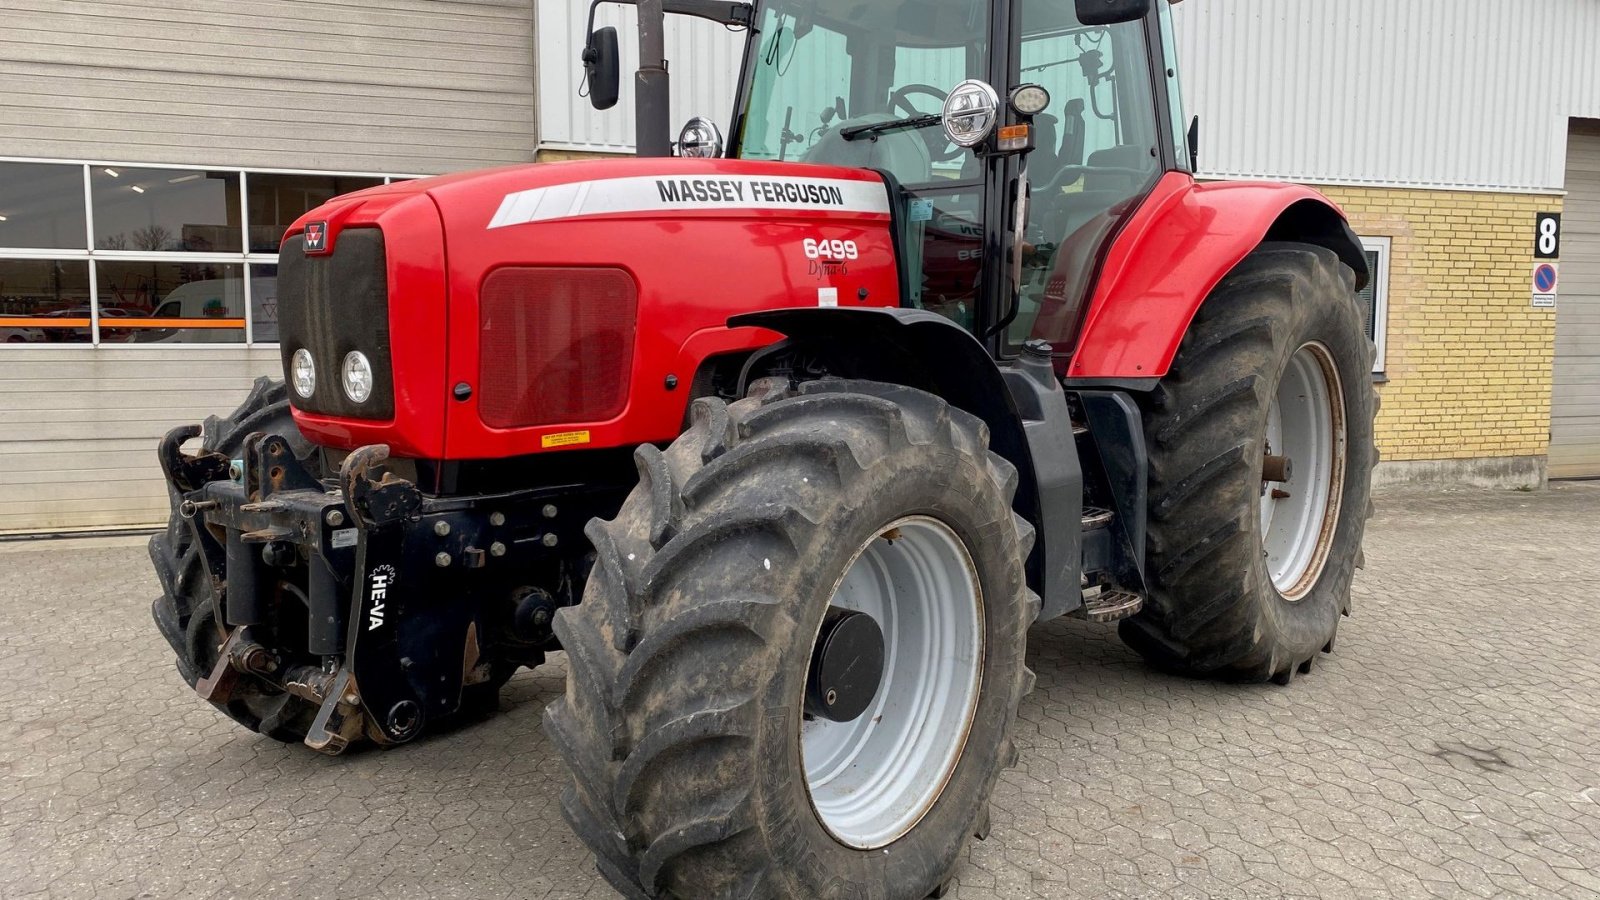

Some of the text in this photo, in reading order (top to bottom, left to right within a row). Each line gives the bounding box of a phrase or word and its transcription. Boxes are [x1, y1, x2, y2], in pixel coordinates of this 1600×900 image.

[656, 180, 844, 205] MASSEY FERGUSON
[1539, 217, 1557, 255] 8
[803, 238, 858, 260] 6499
[807, 259, 848, 280] Dyna-6
[368, 575, 387, 631] HE-VA
